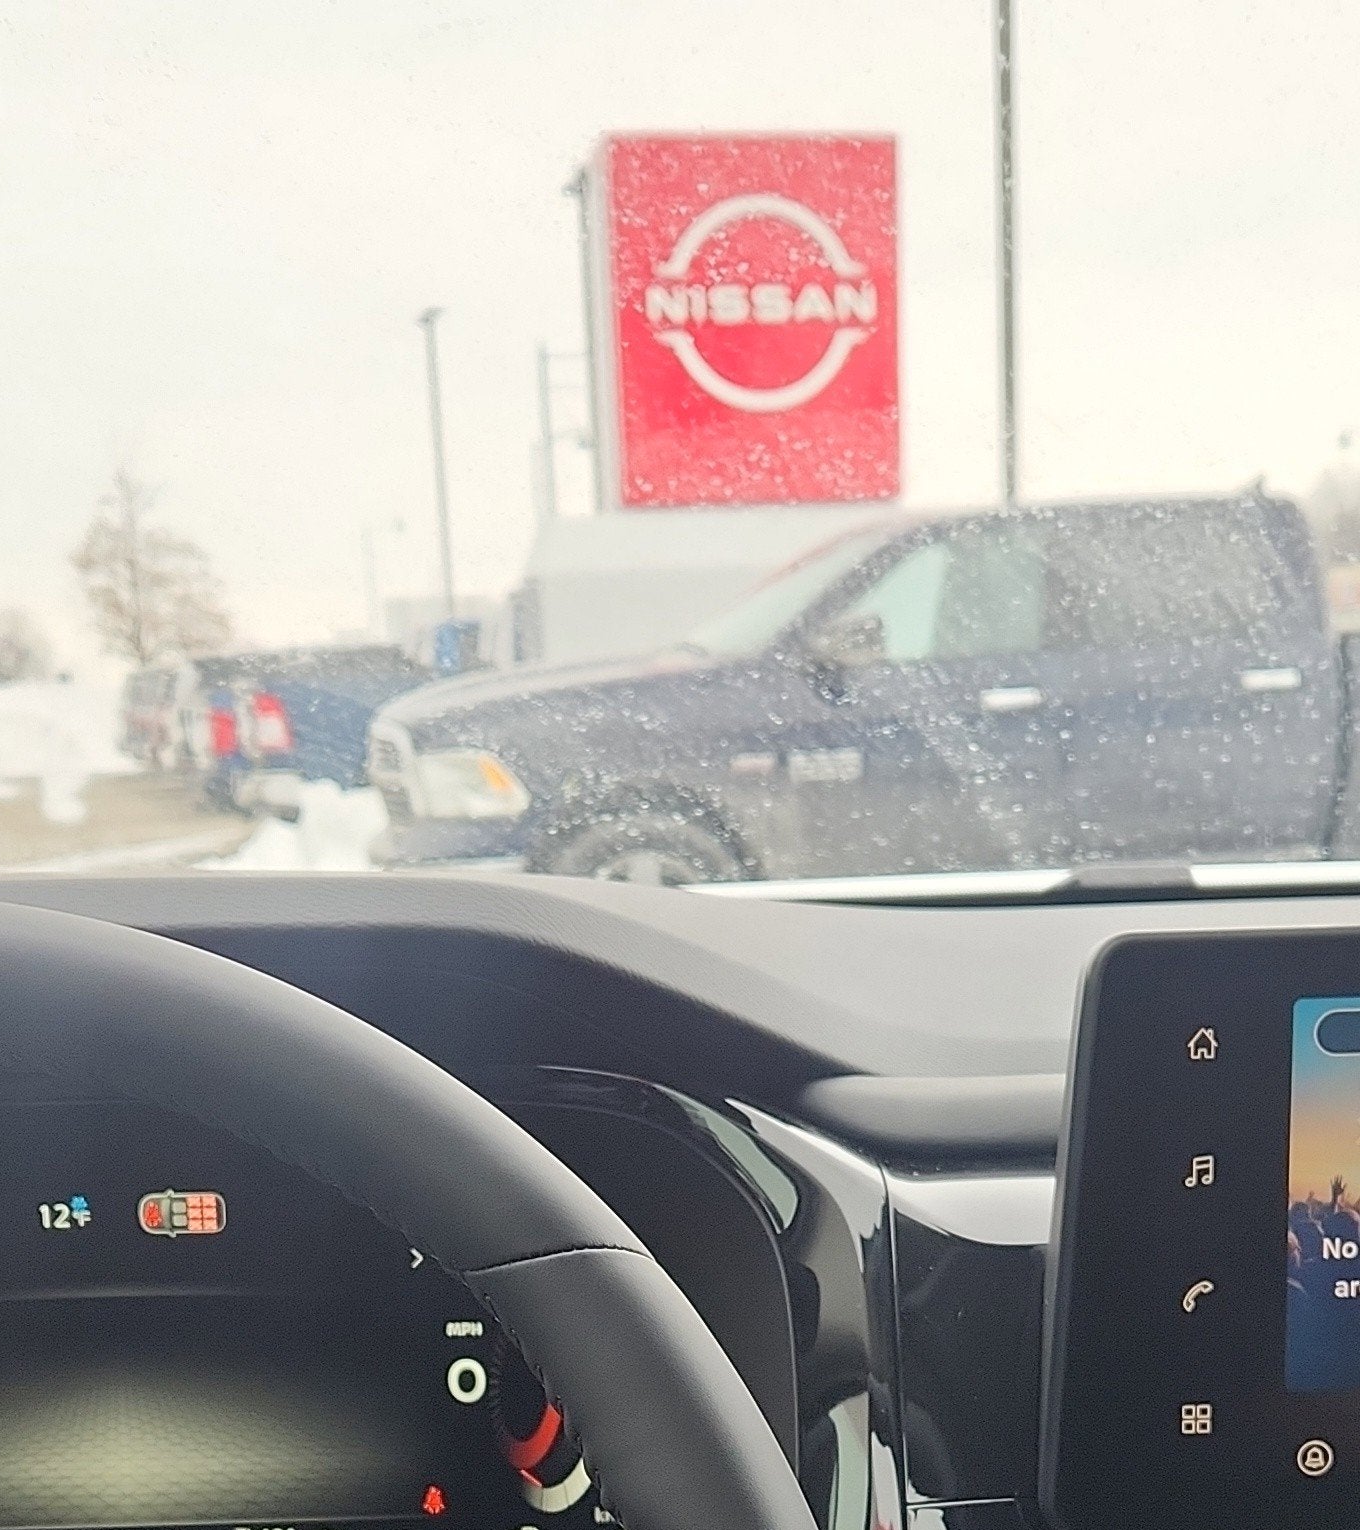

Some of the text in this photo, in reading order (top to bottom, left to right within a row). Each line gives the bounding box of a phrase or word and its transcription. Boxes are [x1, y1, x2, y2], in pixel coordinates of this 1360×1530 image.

[644, 283, 878, 325] NISSAN
[1322, 1236, 1358, 1260] No
[446, 1321, 483, 1338] MPH
[447, 1358, 487, 1403] 0
